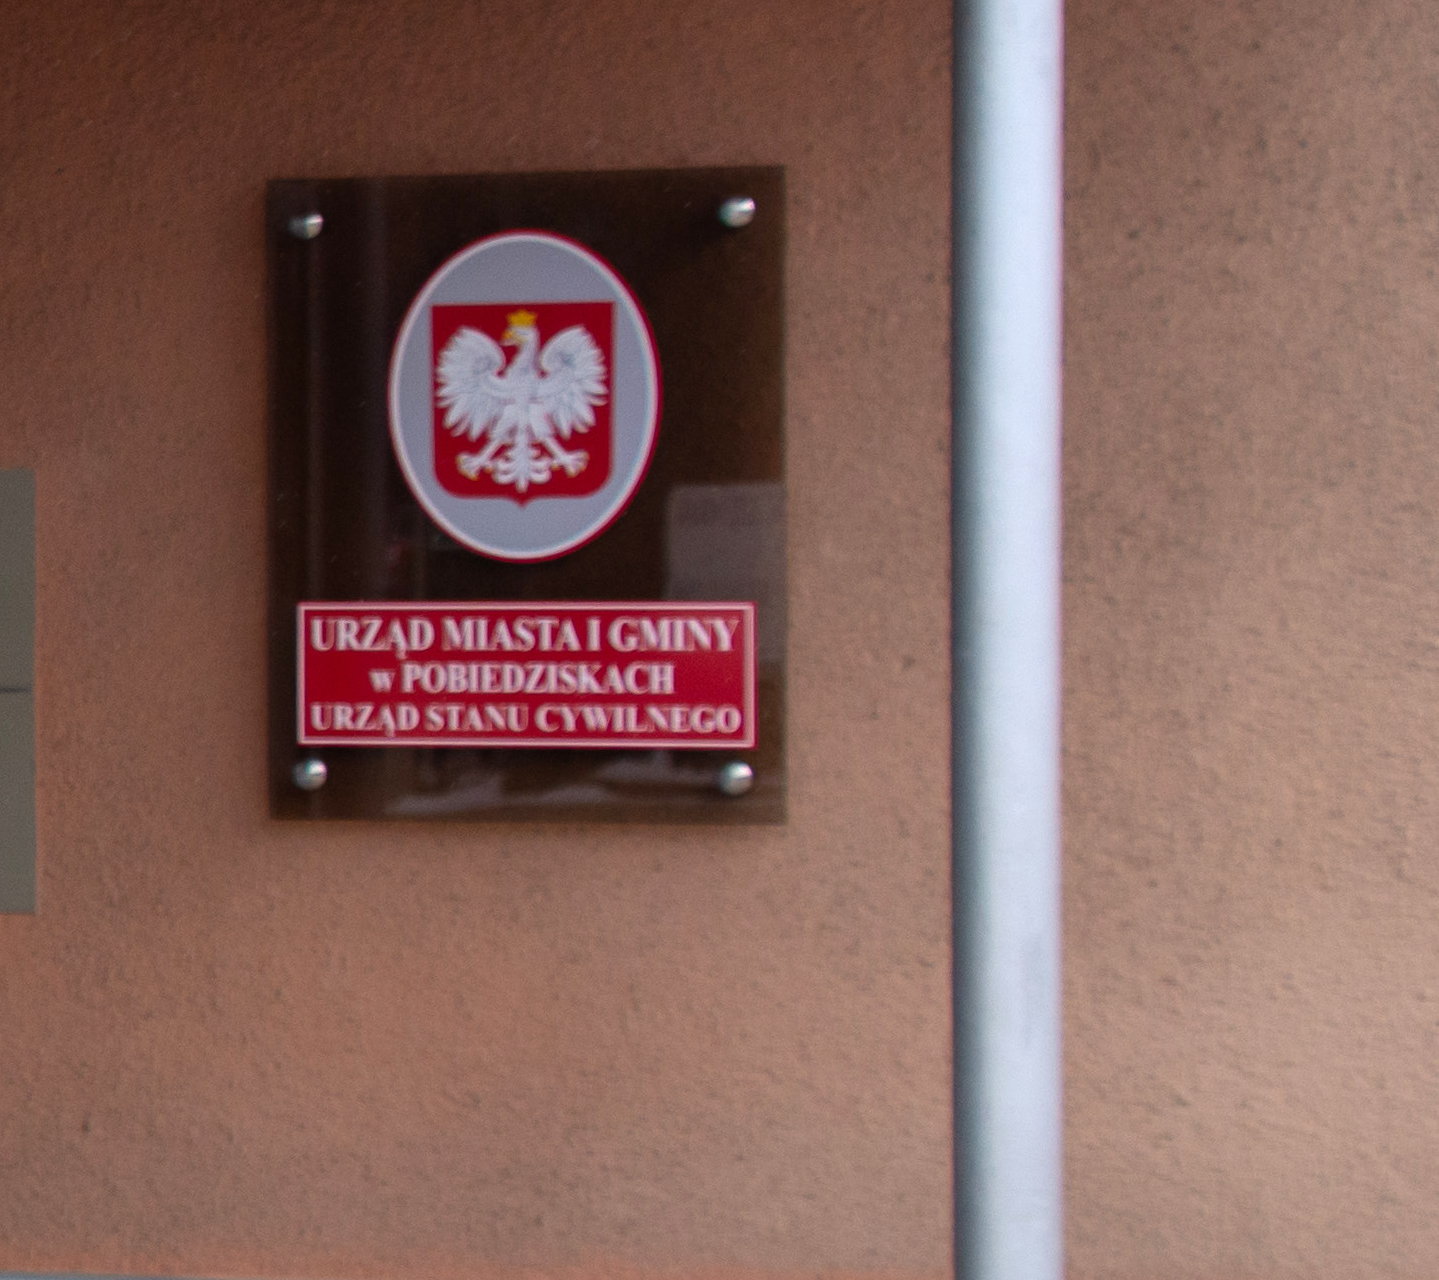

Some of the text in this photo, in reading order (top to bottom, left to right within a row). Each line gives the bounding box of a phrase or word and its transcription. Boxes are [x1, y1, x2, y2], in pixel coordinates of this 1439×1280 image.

[310, 616, 739, 659] URZĄD MIASTA I GMINY
[368, 661, 675, 694] w POBIEDZISKACH
[310, 702, 742, 737] URZĄD STANU CYWILNEGO
